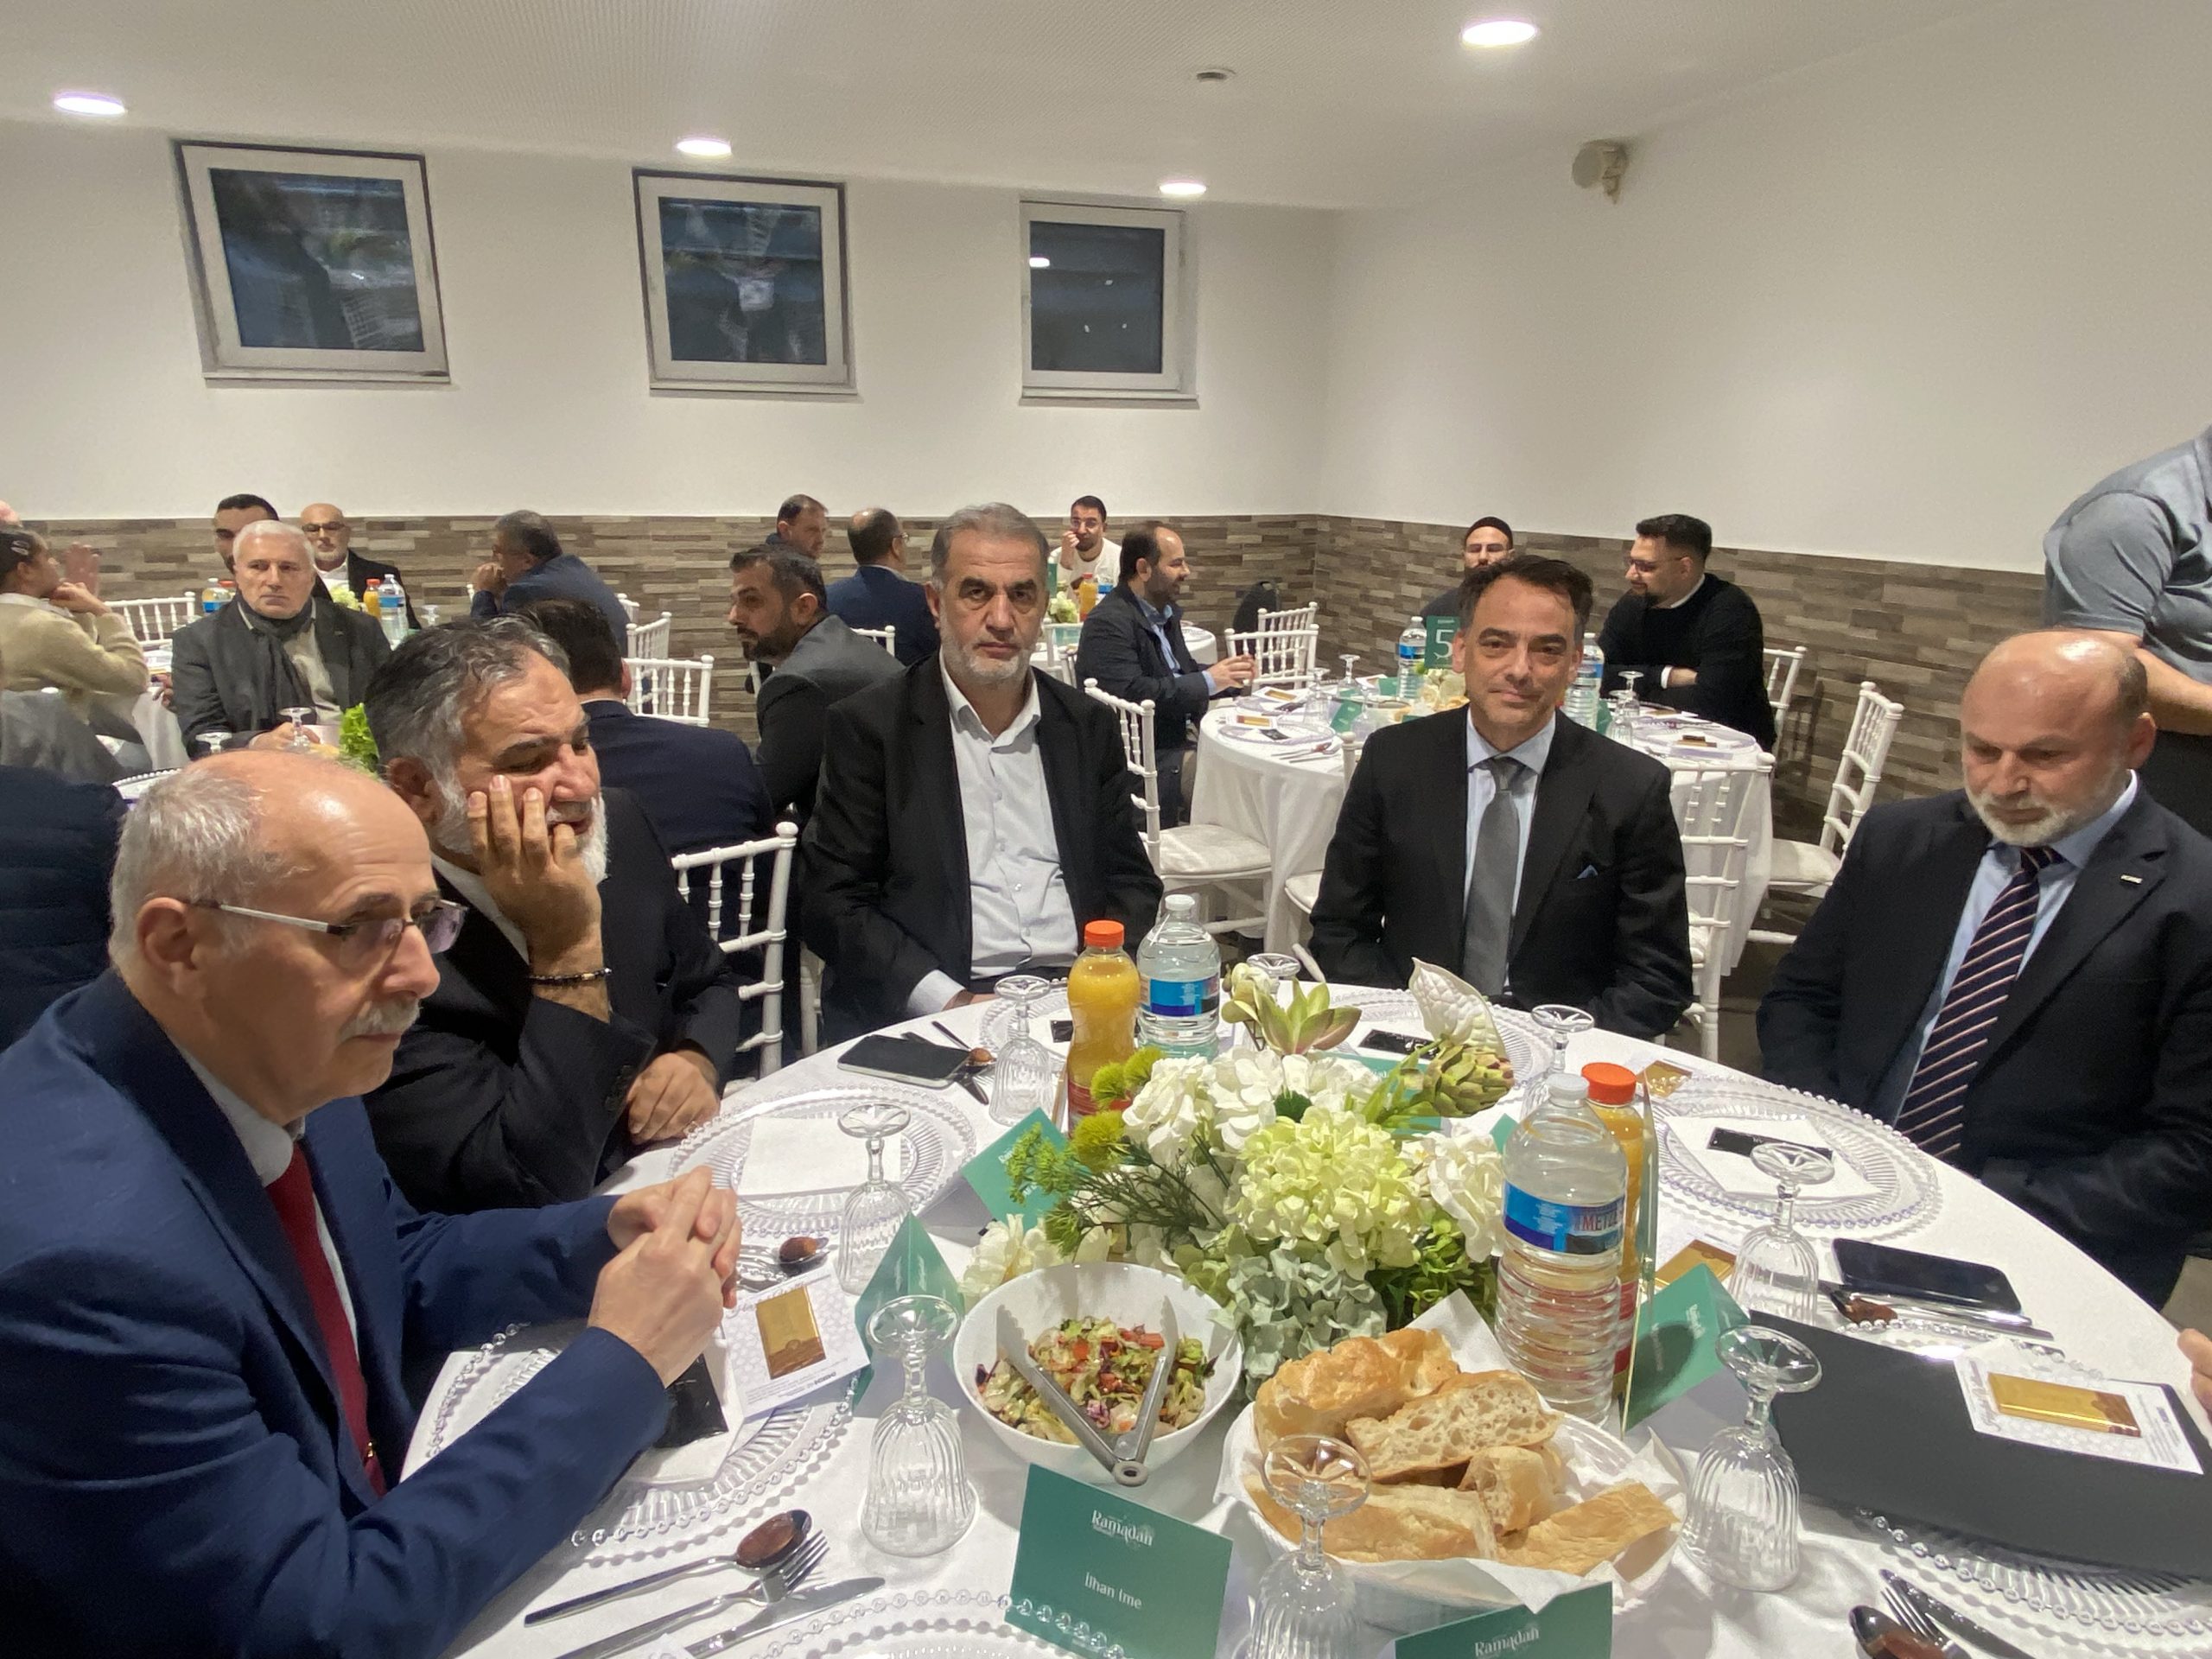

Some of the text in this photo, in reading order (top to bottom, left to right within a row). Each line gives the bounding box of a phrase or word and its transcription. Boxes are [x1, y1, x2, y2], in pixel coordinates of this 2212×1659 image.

[1433, 629, 1453, 659] 5
[1091, 1510, 1154, 1546] Ramadan
[1474, 1626, 1540, 1657] Ramadan
